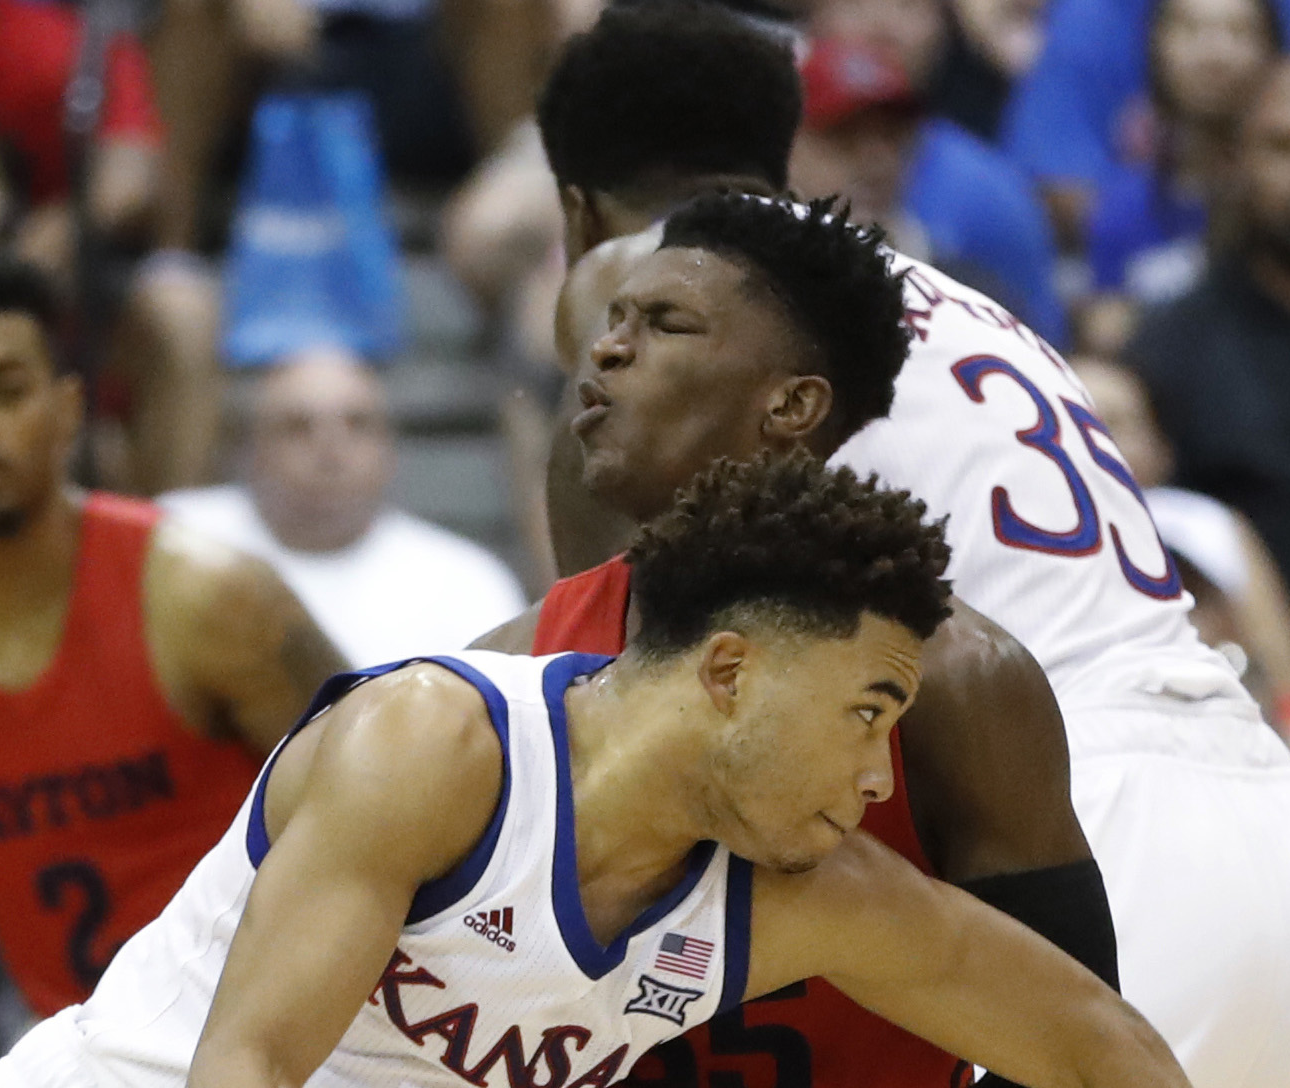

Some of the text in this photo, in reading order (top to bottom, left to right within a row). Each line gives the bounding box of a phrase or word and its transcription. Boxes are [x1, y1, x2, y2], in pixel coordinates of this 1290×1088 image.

[950, 353, 1184, 601] 35
[33, 859, 116, 990] 2
[463, 915, 516, 952] adidas
